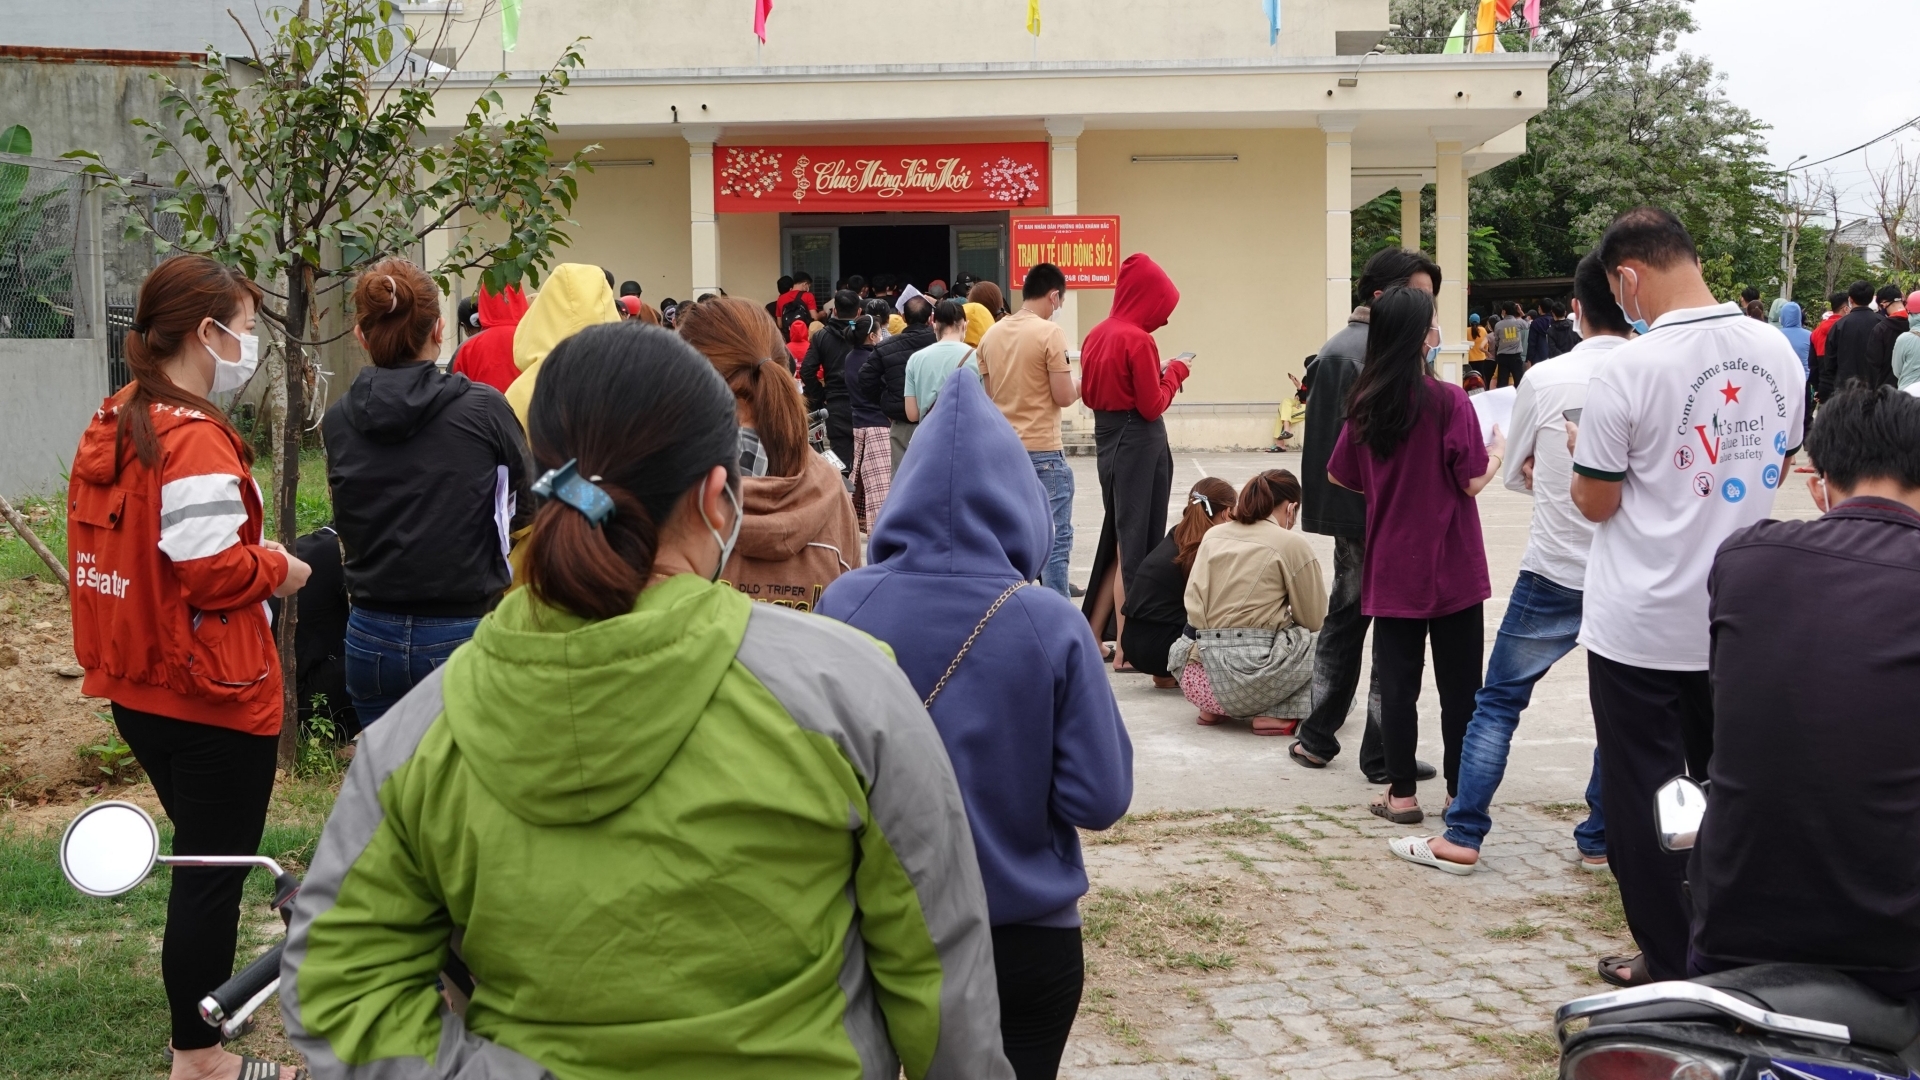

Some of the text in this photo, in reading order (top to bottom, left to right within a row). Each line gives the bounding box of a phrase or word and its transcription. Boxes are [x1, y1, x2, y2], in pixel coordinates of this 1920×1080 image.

[814, 158, 973, 198] Chúc Mừng Năm Mới
[1040, 244, 1045, 264] Y
[1047, 236, 1056, 266] TẾ
[1058, 241, 1072, 267] LƯU
[1073, 238, 1094, 272] ĐỘNG
[1095, 235, 1106, 267] SỐ
[1107, 243, 1112, 266] 2
[1077, 274, 1090, 283] (Chị
[1092, 274, 1110, 282] Dung)
[1677, 358, 1787, 436] Come home safe everyday
[1735, 415, 1764, 433] me!
[1741, 434, 1761, 447] life
[1734, 449, 1763, 461] safety
[767, 584, 805, 596] TRIPER
